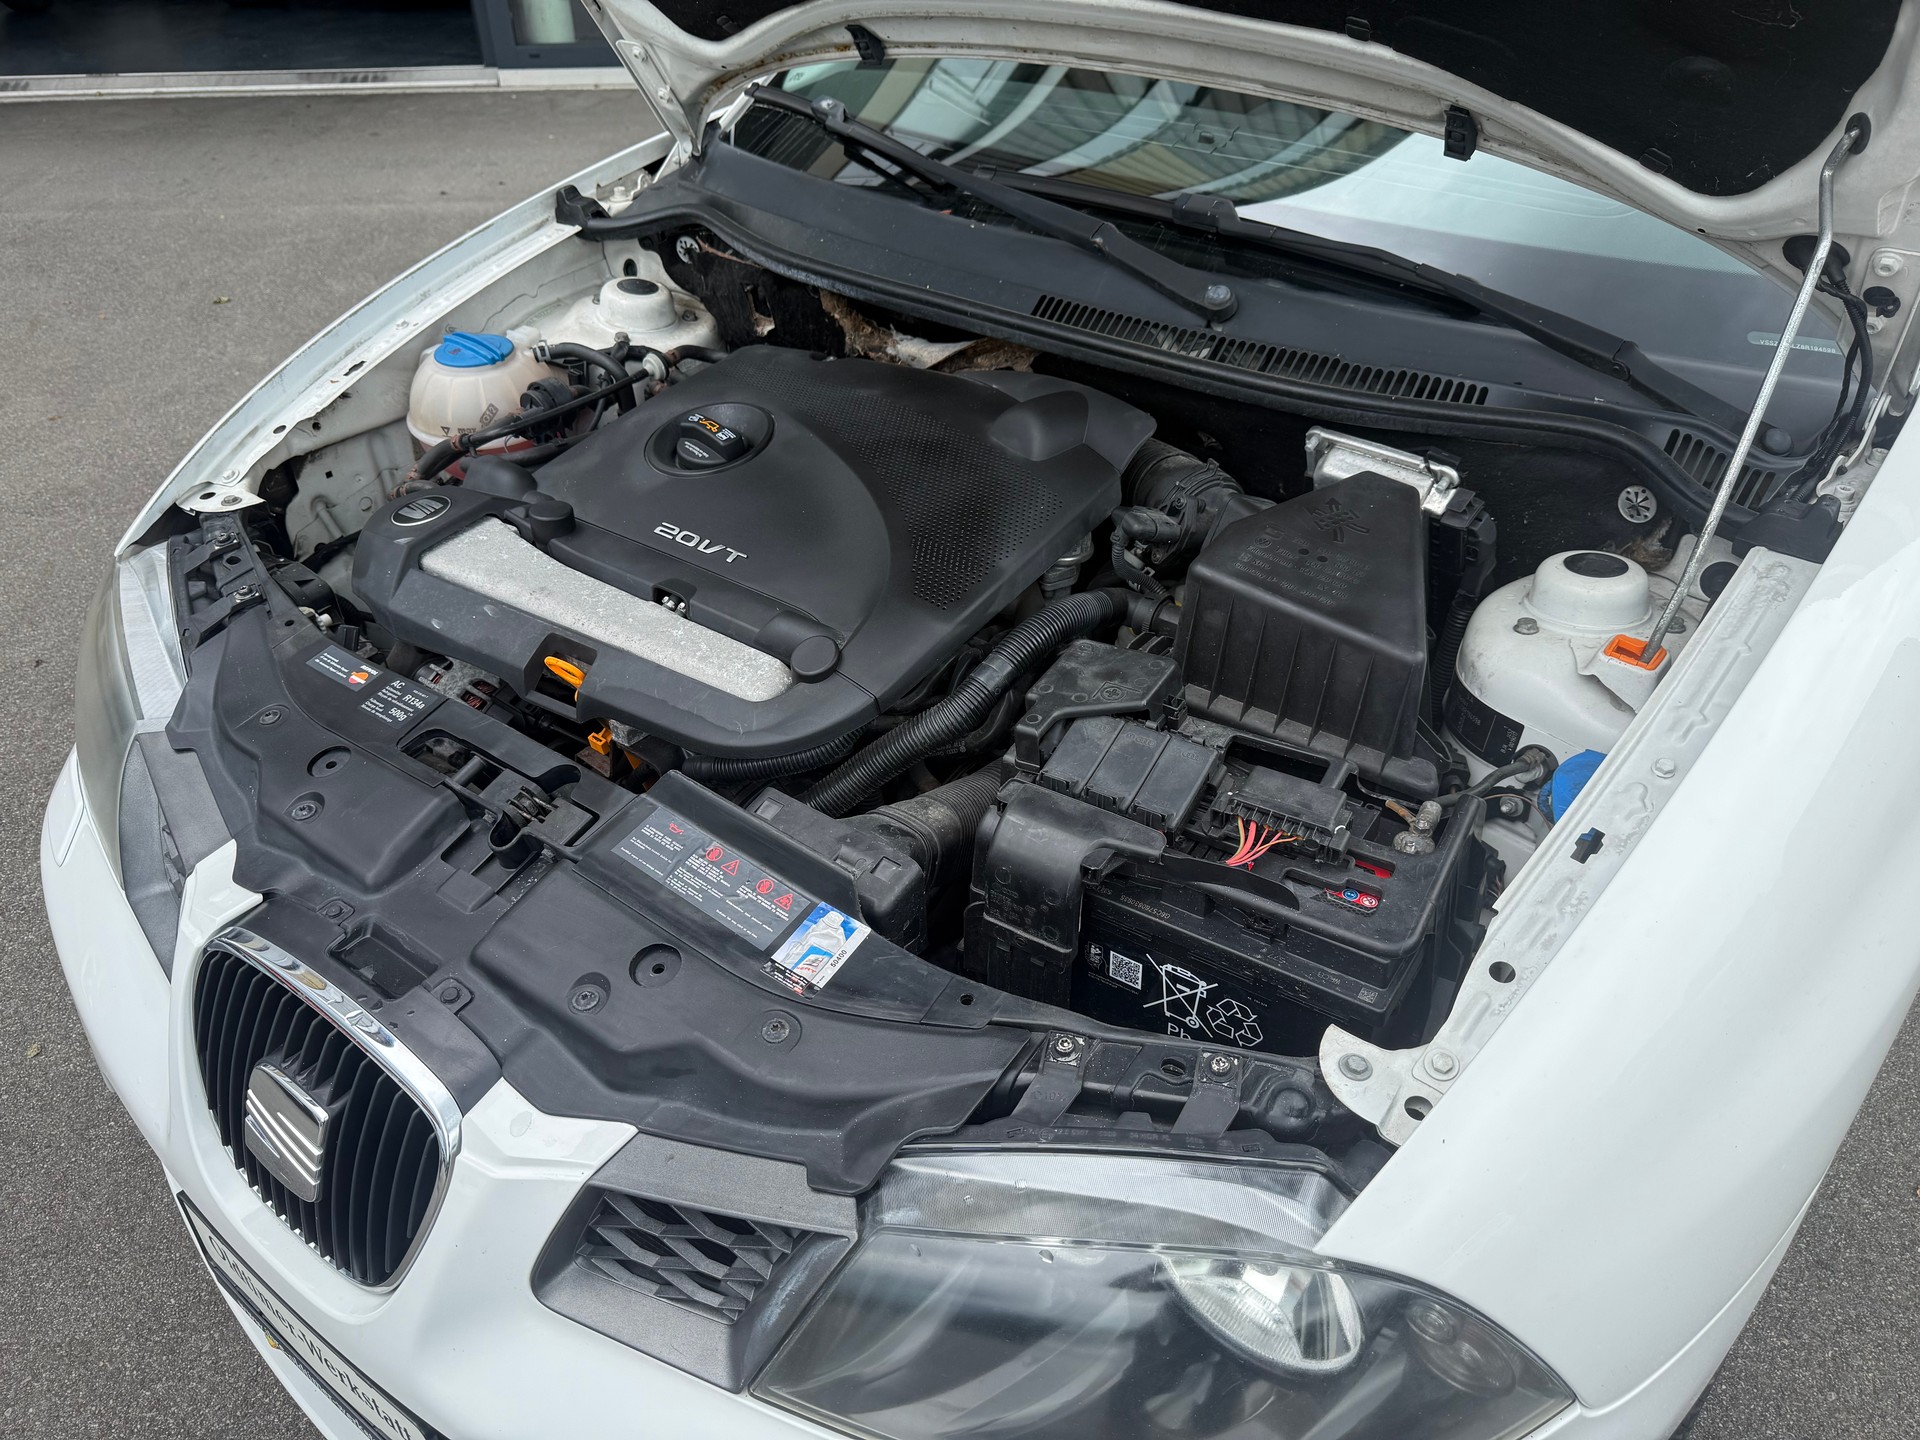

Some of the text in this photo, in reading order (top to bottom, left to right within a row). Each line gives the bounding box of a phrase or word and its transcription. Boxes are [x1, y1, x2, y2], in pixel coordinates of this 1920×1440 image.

[654, 521, 748, 563] 20VT
[391, 680, 405, 689] AC
[402, 694, 425, 710] R134a
[388, 707, 408, 722] 500g
